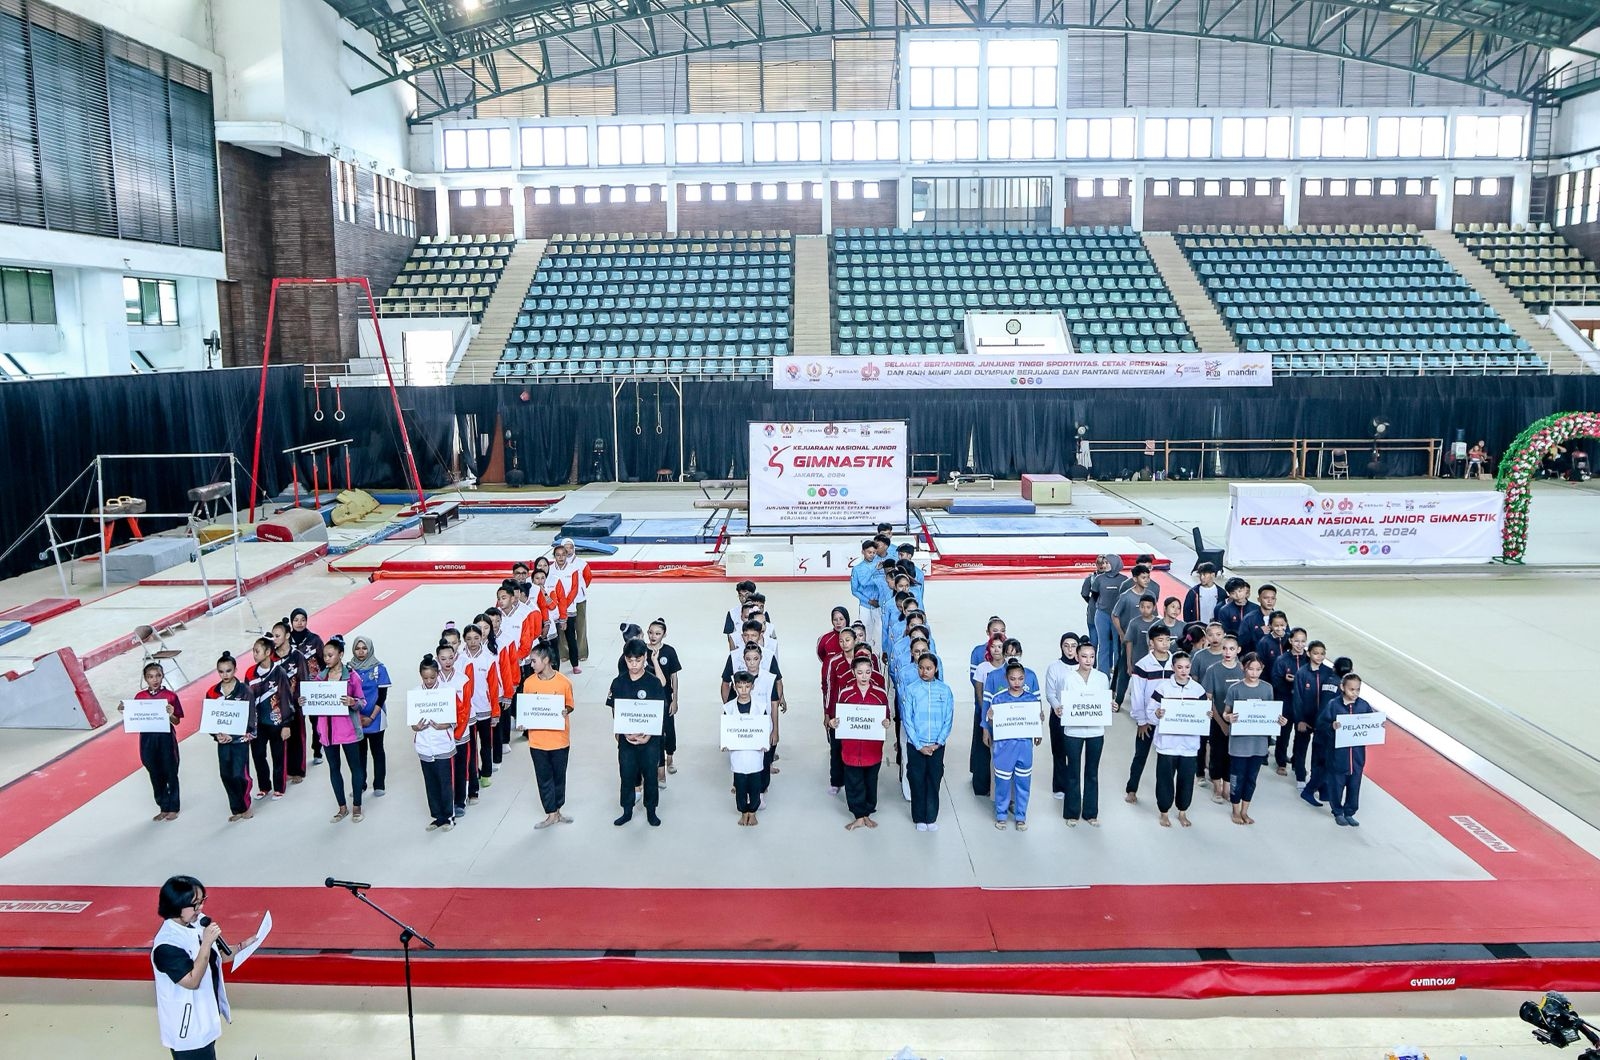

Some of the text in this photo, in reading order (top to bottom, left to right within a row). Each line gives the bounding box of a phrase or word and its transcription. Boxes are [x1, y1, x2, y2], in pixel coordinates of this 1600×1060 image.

[793, 456, 895, 468] GIMNASTIK
[1240, 513, 1497, 526] KEJUARAAN NASIONAL JUNIOR GIMNASTIK
[1319, 528, 1417, 537] JAKARTA, 2024
[753, 554, 764, 566] 2
[822, 550, 830, 568] 1
[1410, 978, 1456, 986] GYMNOVA
